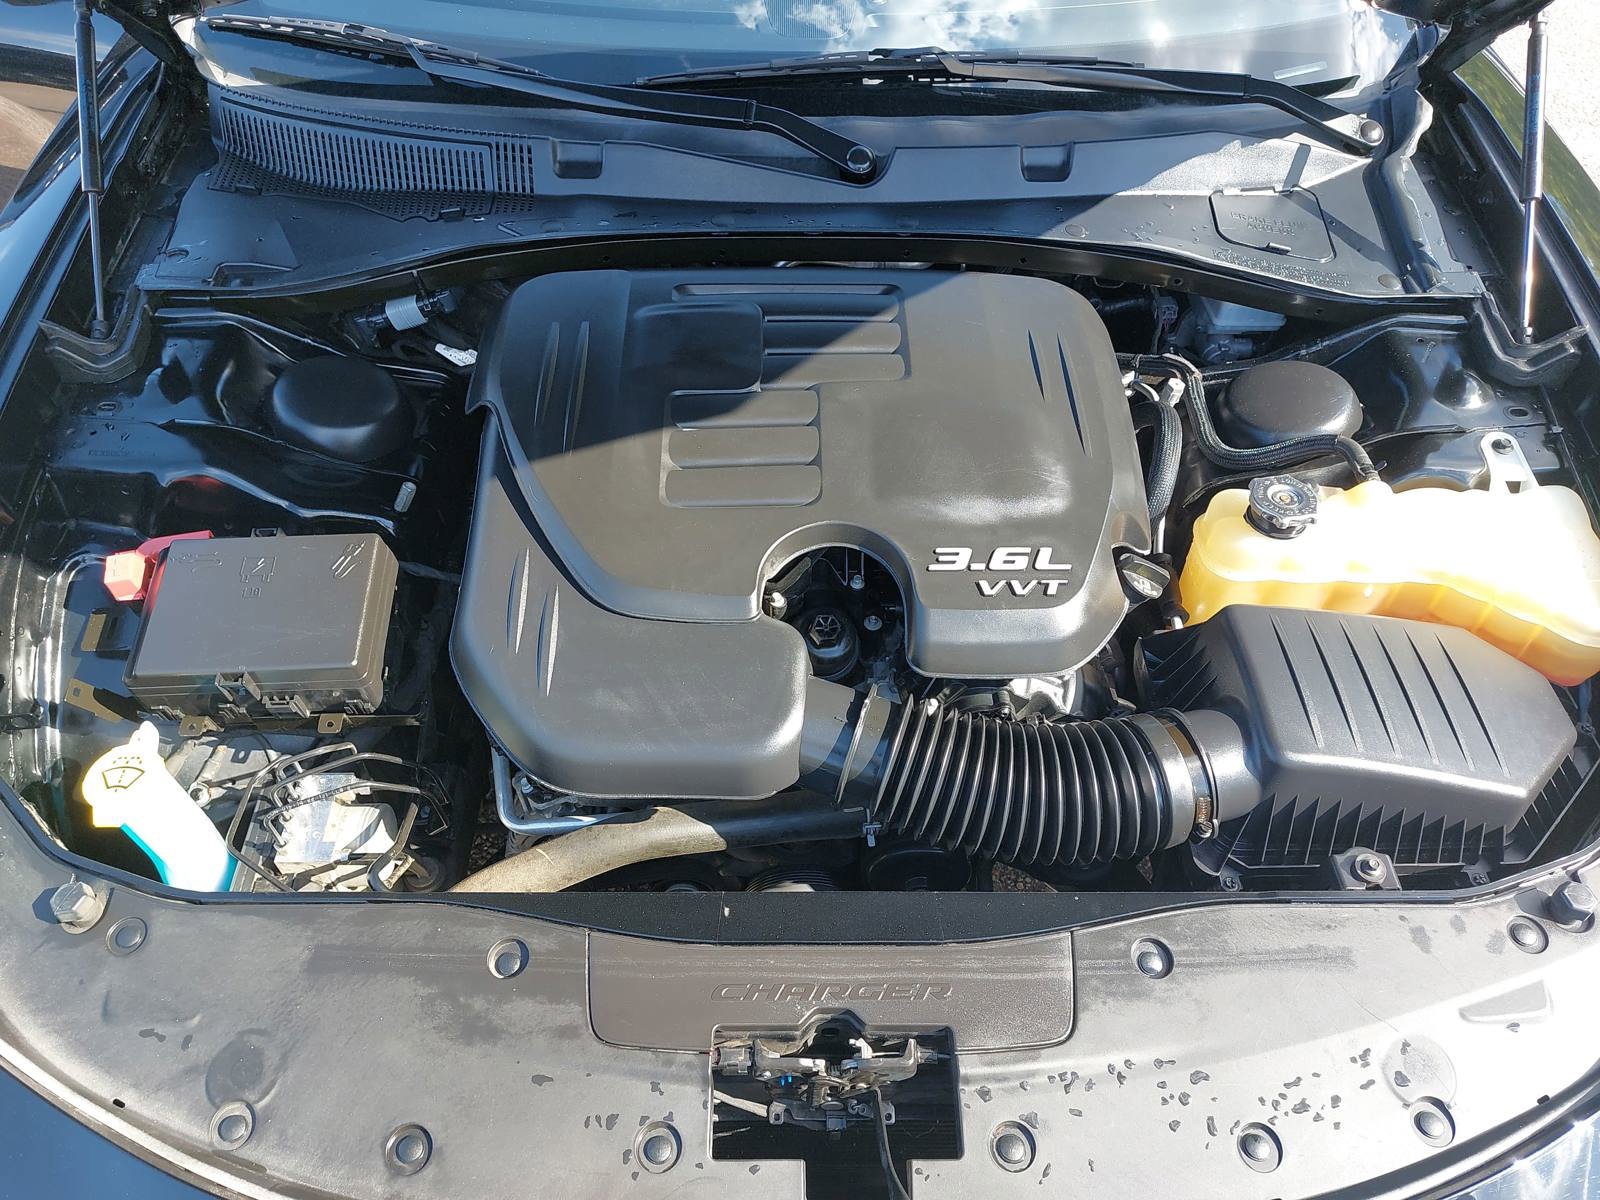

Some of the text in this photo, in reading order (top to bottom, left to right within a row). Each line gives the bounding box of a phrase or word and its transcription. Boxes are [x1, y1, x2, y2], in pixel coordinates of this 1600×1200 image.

[1230, 211, 1272, 225] BRAKE
[1247, 222, 1296, 236] ACCESS
[926, 547, 1073, 572] 3.6L
[975, 579, 1069, 597] VVT
[710, 983, 953, 1001] CHARGER
